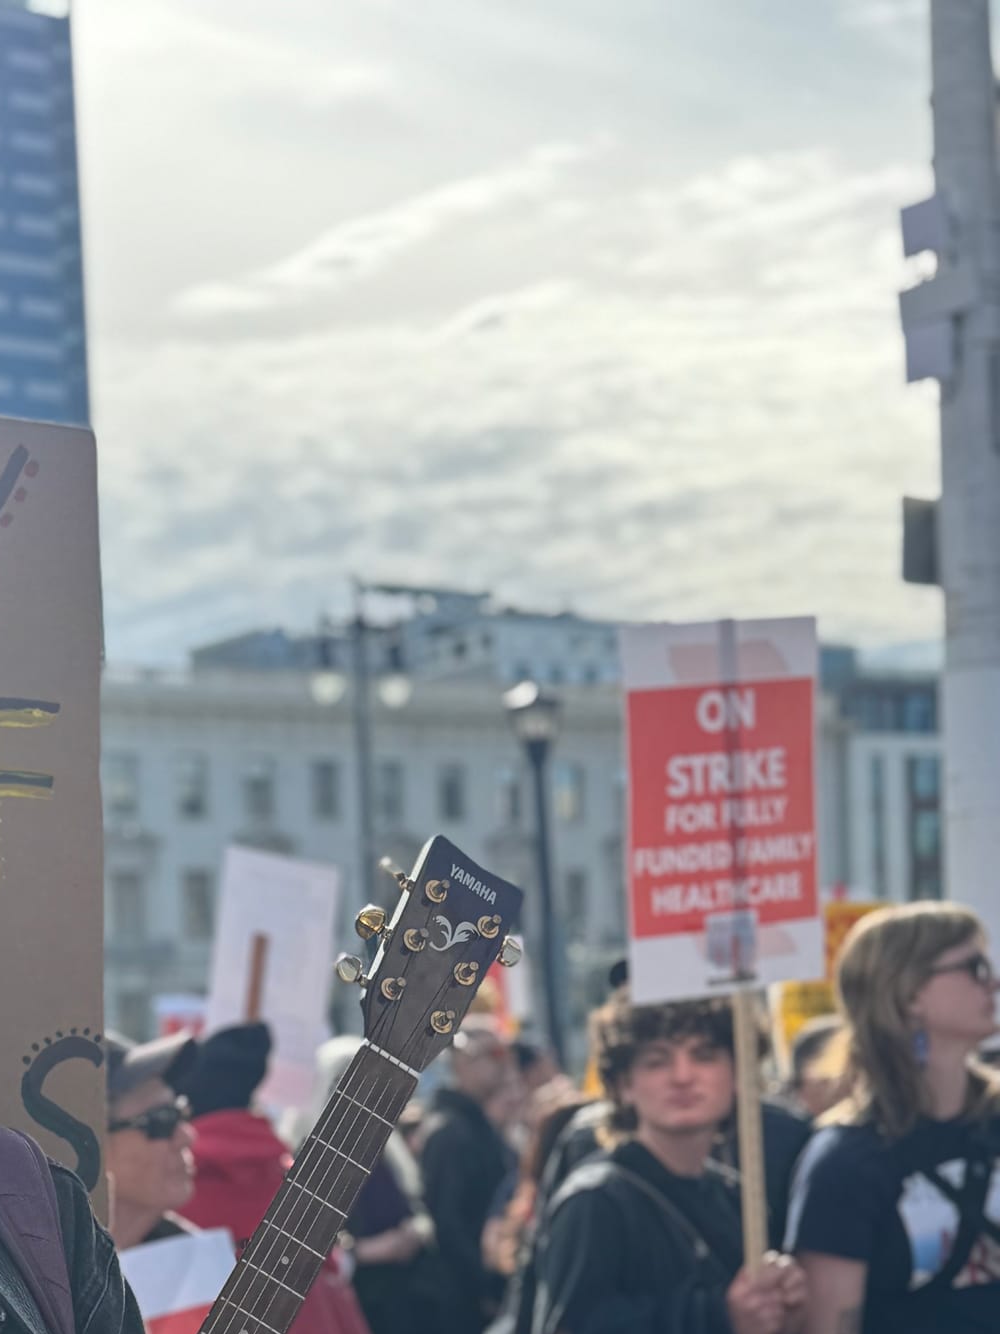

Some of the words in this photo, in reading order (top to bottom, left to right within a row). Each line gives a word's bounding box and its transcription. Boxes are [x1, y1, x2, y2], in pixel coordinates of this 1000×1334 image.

[696, 690, 755, 733] ON
[667, 748, 786, 796] STRIKE
[665, 802, 717, 835] FOR
[723, 797, 788, 827] FULLY
[634, 842, 733, 876] FUNDED
[738, 833, 813, 865] FAMILY
[450, 863, 497, 905] YAMAHA
